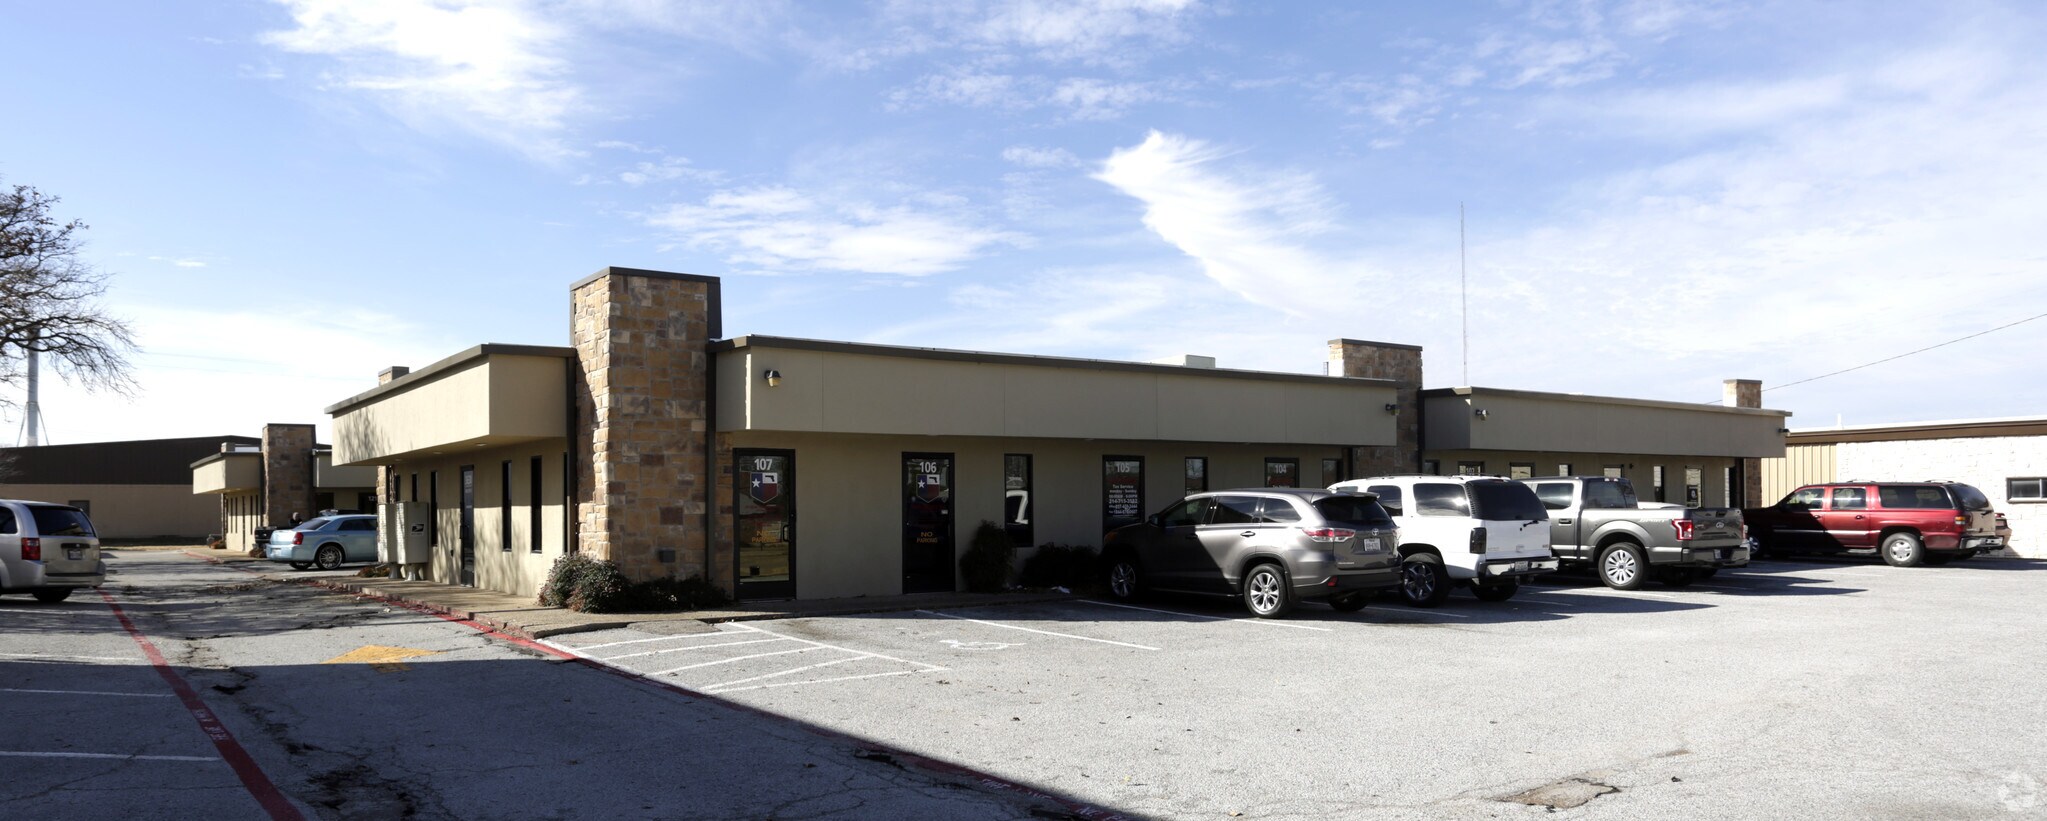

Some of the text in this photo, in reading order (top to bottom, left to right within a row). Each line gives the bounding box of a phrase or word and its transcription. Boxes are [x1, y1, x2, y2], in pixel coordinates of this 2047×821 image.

[754, 458, 773, 471] 107
[919, 461, 937, 473] 106
[1116, 462, 1130, 473] 105
[1275, 463, 1287, 474] 104
